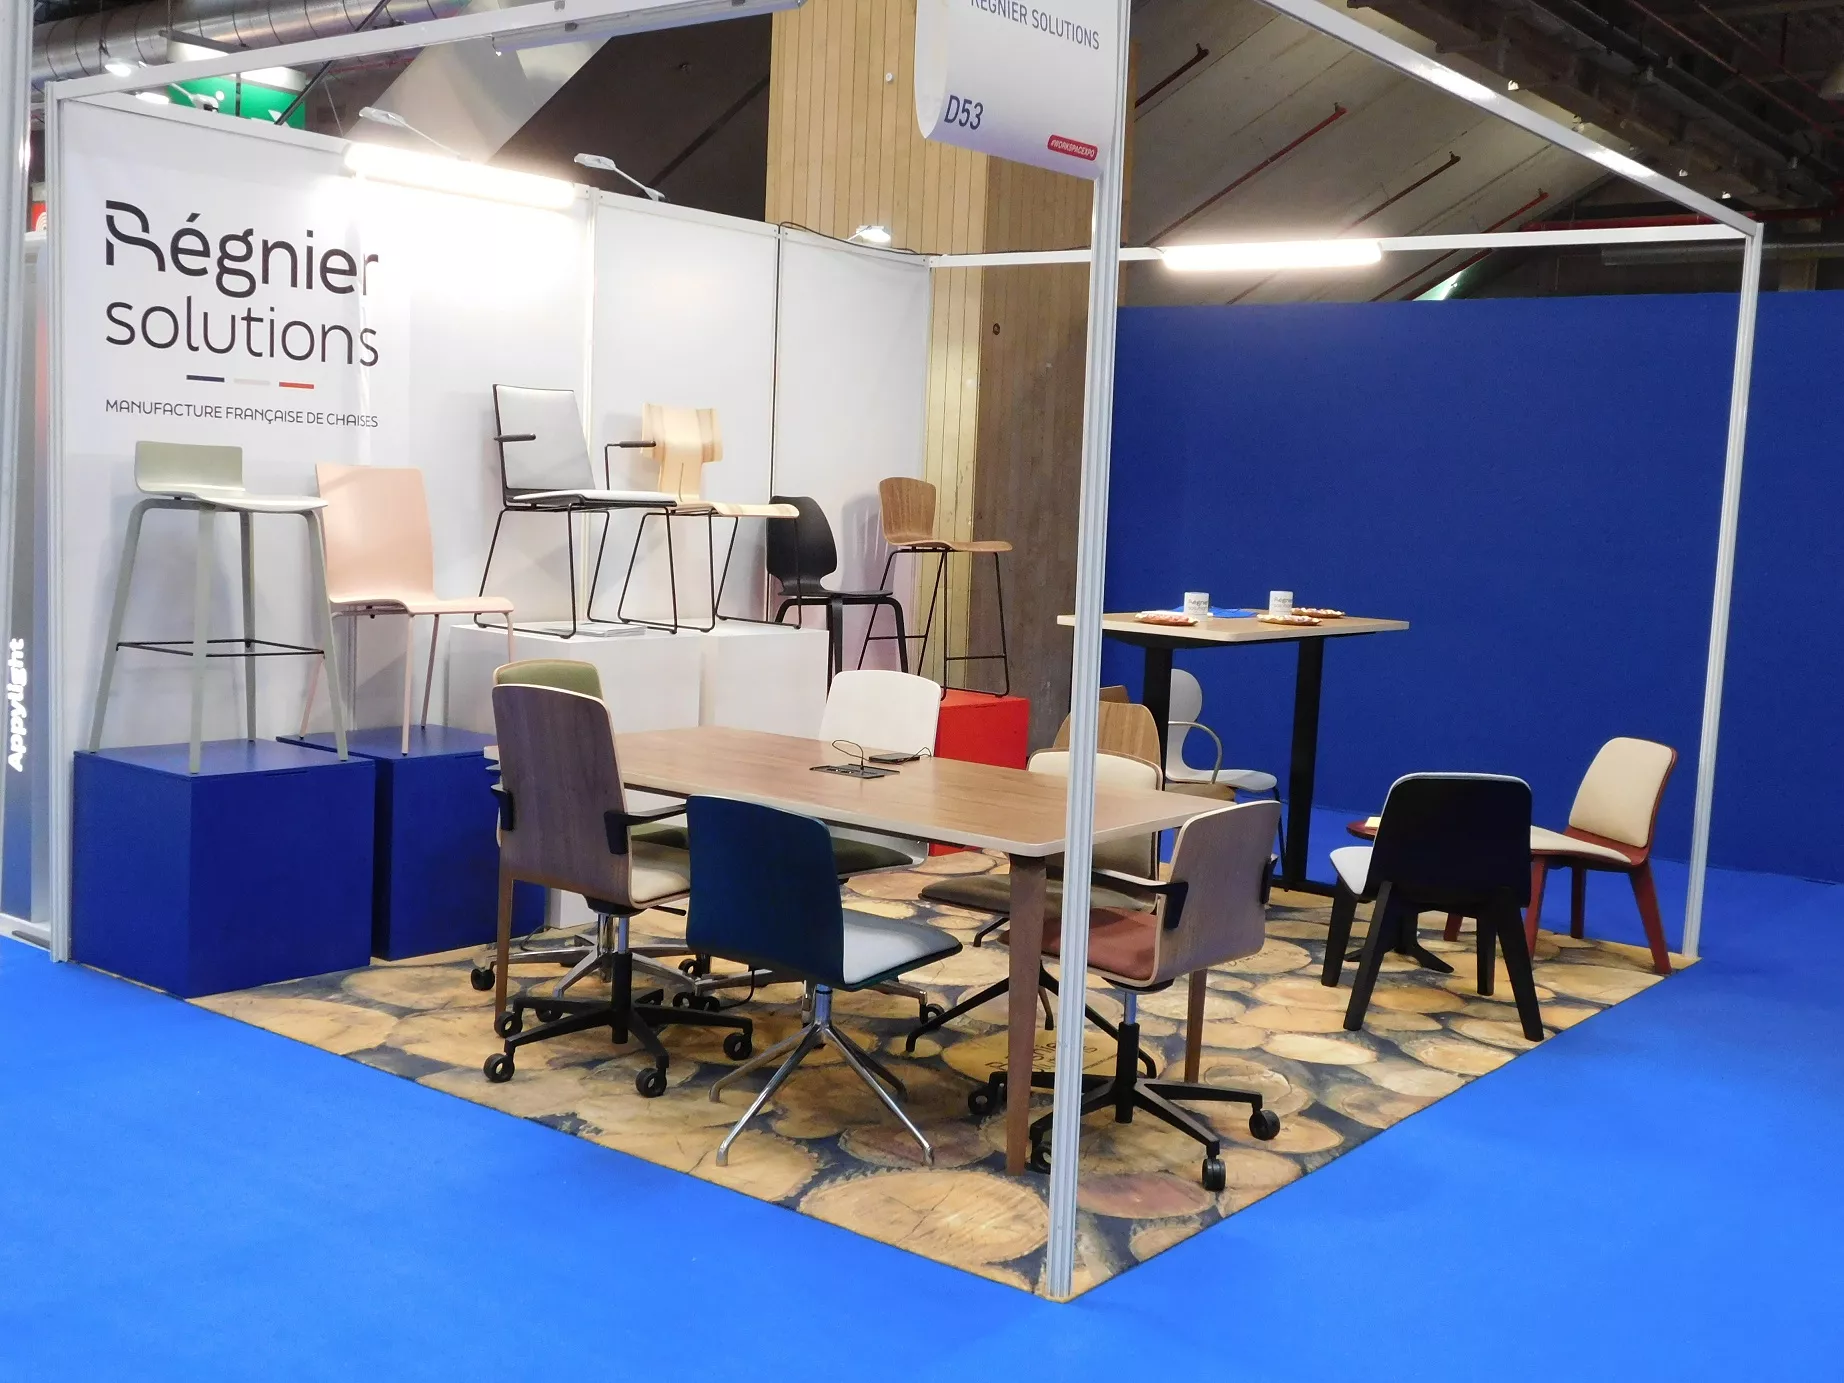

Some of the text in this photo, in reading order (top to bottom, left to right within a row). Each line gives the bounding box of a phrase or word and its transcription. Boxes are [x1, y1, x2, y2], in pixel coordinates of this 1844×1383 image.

[1031, 9, 1100, 50] SOLUTIONS
[944, 94, 984, 130] D53
[105, 199, 379, 298] Régnier
[105, 296, 379, 367] solutions
[105, 399, 379, 428] MANUFACTURE FRANÇAISE DE CHAISES
[6, 638, 28, 773] Appylight
